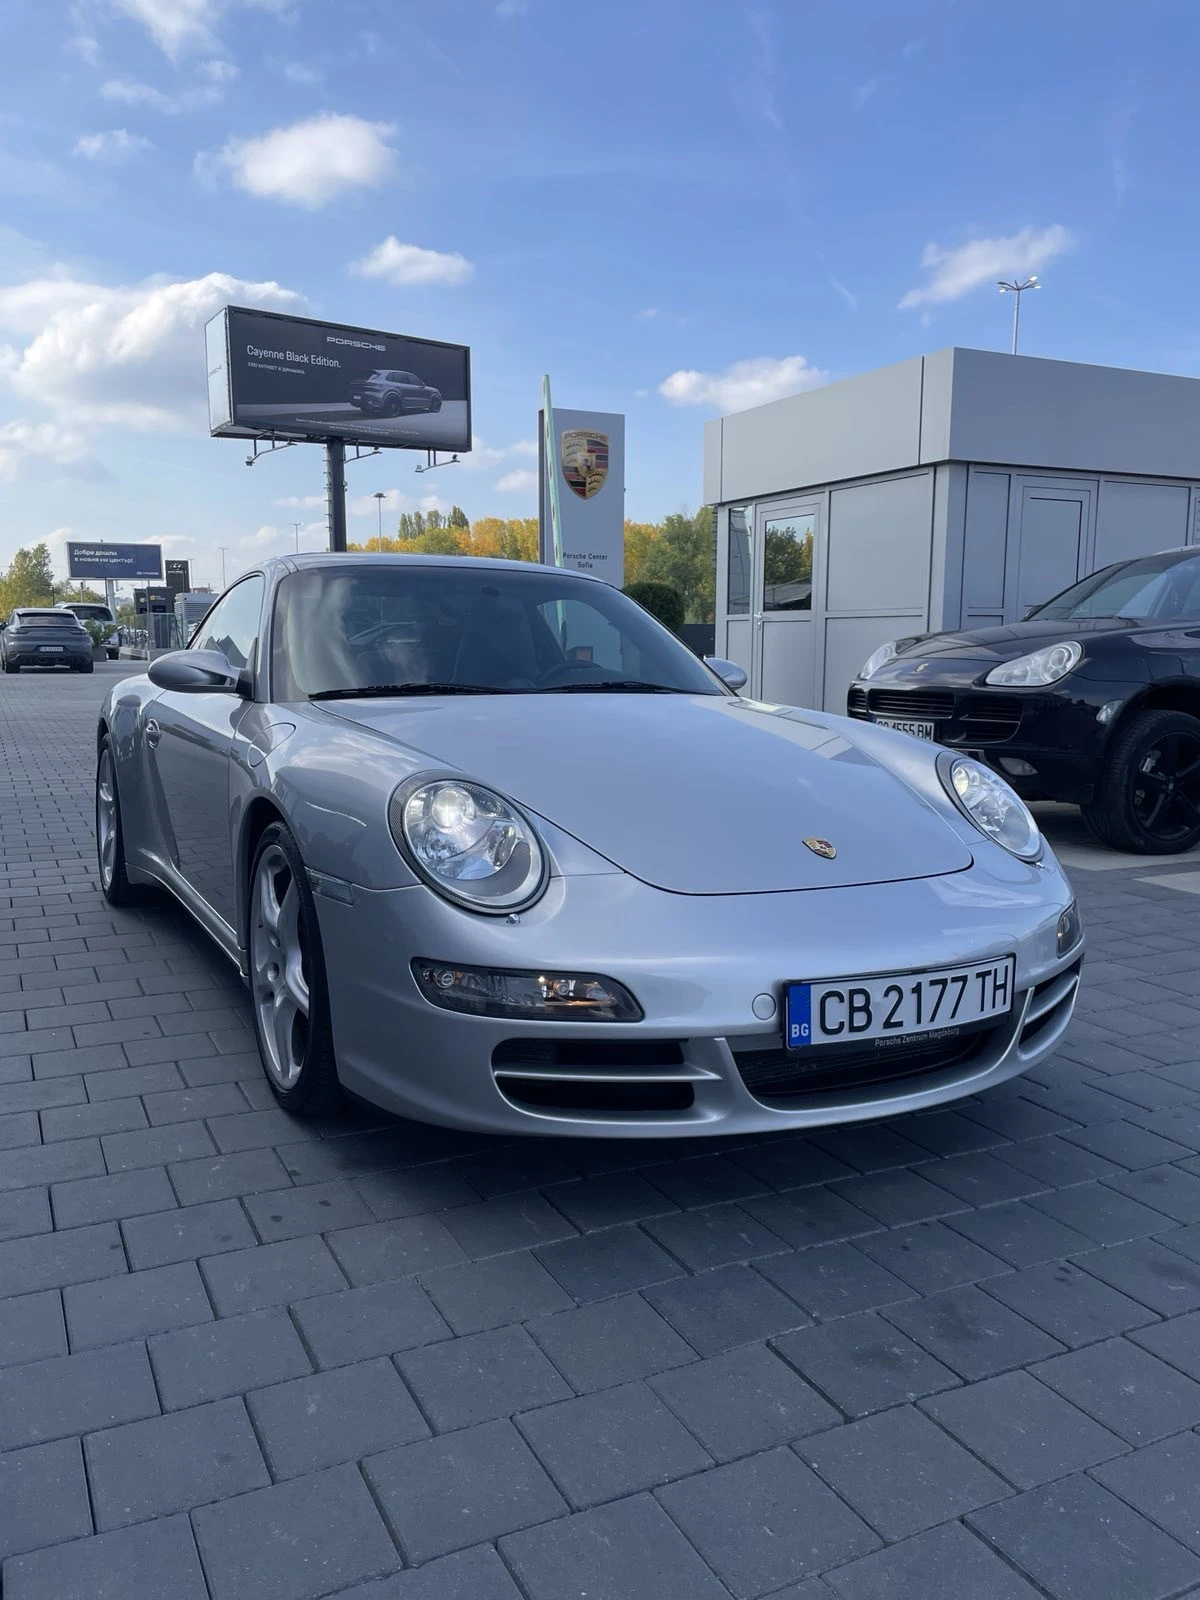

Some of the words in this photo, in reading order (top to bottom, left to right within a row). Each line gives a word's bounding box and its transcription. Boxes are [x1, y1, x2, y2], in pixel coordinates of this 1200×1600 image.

[326, 336, 387, 352] PORSCHE
[246, 345, 284, 360] Cayenne
[286, 351, 310, 363] Black
[311, 355, 342, 368] Edition.
[562, 552, 587, 560] Porsche
[577, 561, 593, 569] Sofia
[819, 987, 873, 1036] CB
[882, 974, 969, 1030] 2177
[975, 964, 1009, 1012] TH
[791, 1023, 809, 1038] BG
[875, 1036, 901, 1047] Porsche
[902, 1033, 928, 1043] Zentrum
[929, 1028, 960, 1039] Magdeburg
